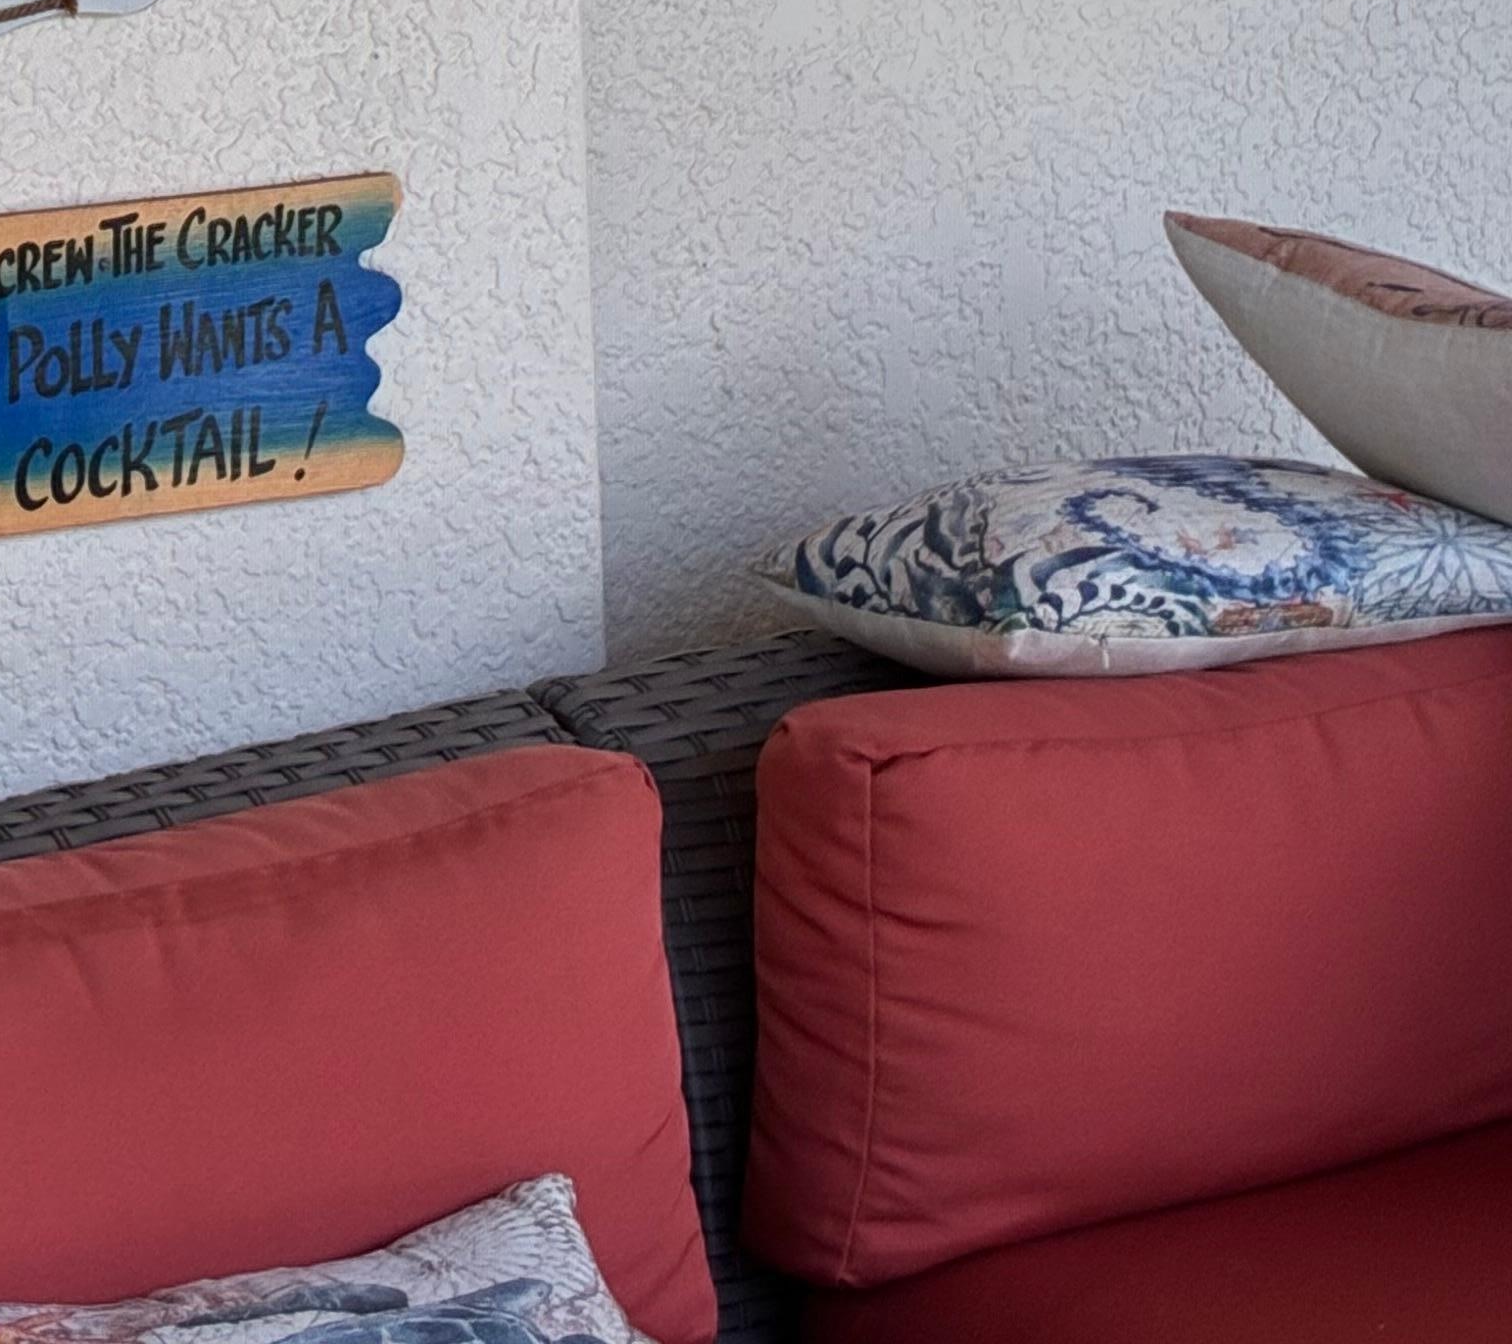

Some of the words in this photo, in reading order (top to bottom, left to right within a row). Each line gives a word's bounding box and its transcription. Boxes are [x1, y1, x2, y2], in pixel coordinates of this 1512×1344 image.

[99, 212, 167, 278] THE
[176, 203, 343, 271] CRACKER
[8, 317, 144, 405] POLLY
[158, 296, 294, 382] WANTS
[312, 277, 350, 356] A
